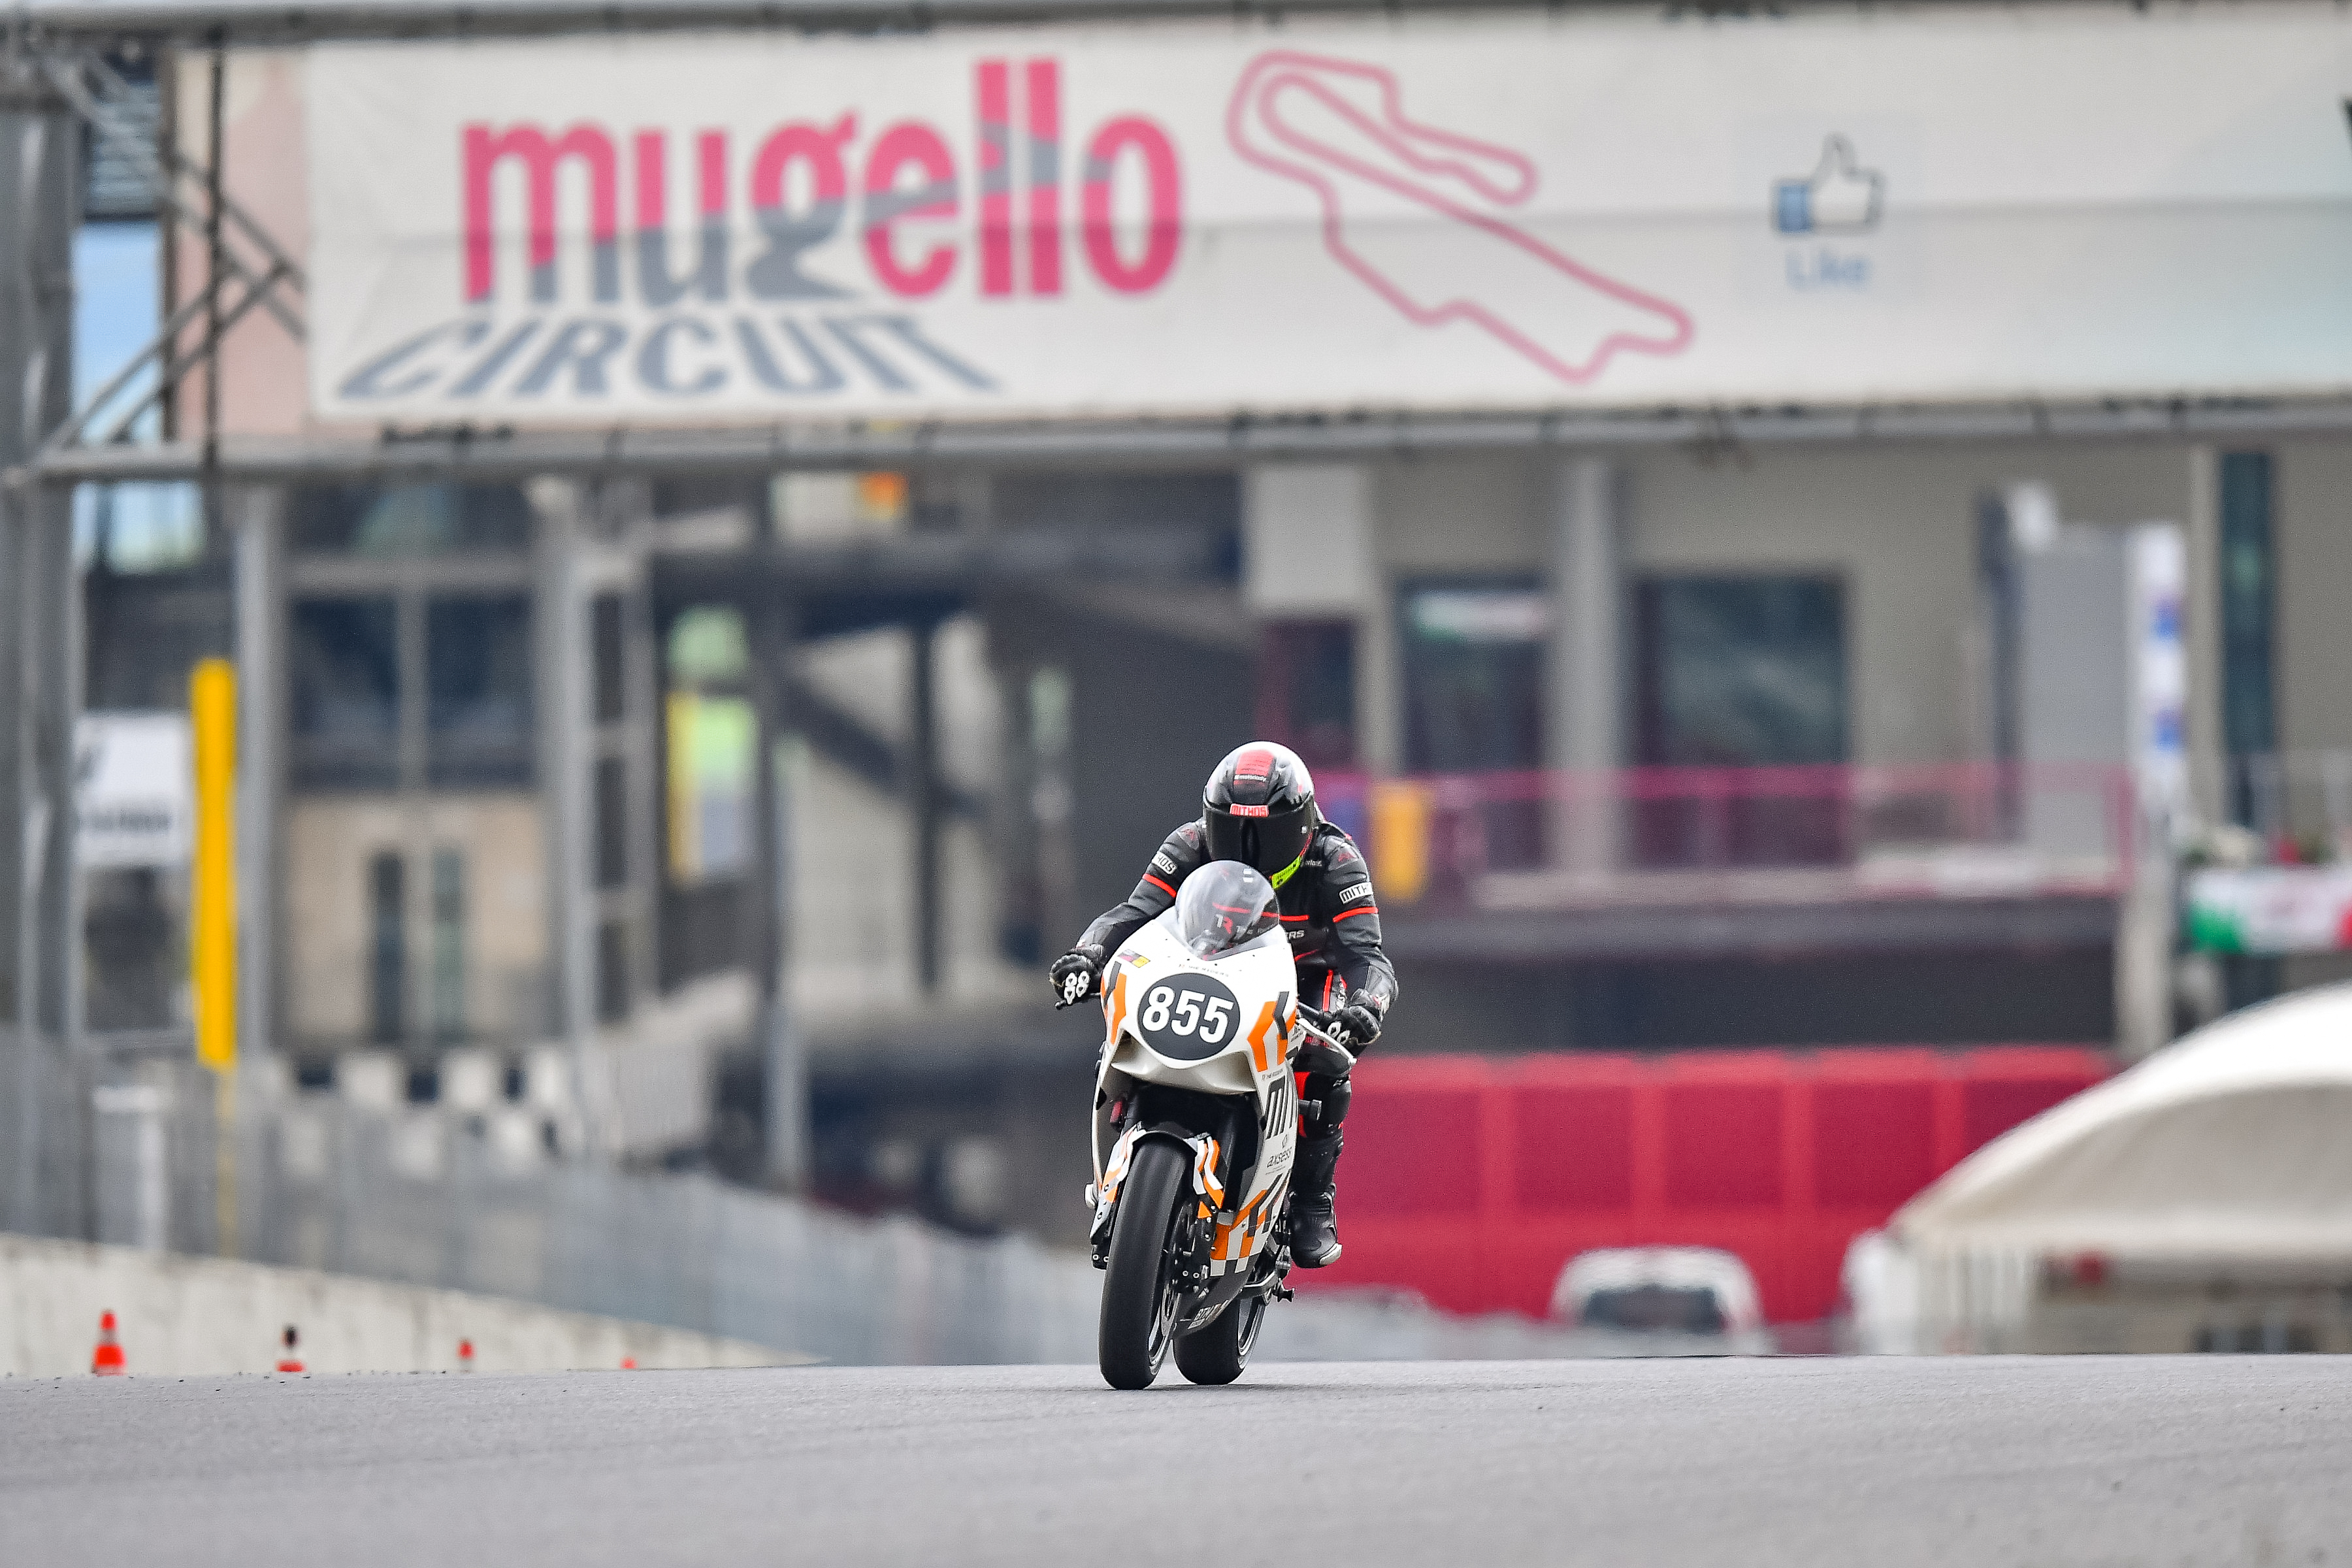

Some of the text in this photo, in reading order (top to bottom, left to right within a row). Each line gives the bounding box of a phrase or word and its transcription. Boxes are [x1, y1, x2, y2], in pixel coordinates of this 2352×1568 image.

[461, 56, 1184, 308] mugello
[336, 314, 1002, 398] CIRCUIT
[1142, 985, 1235, 1044] 855
